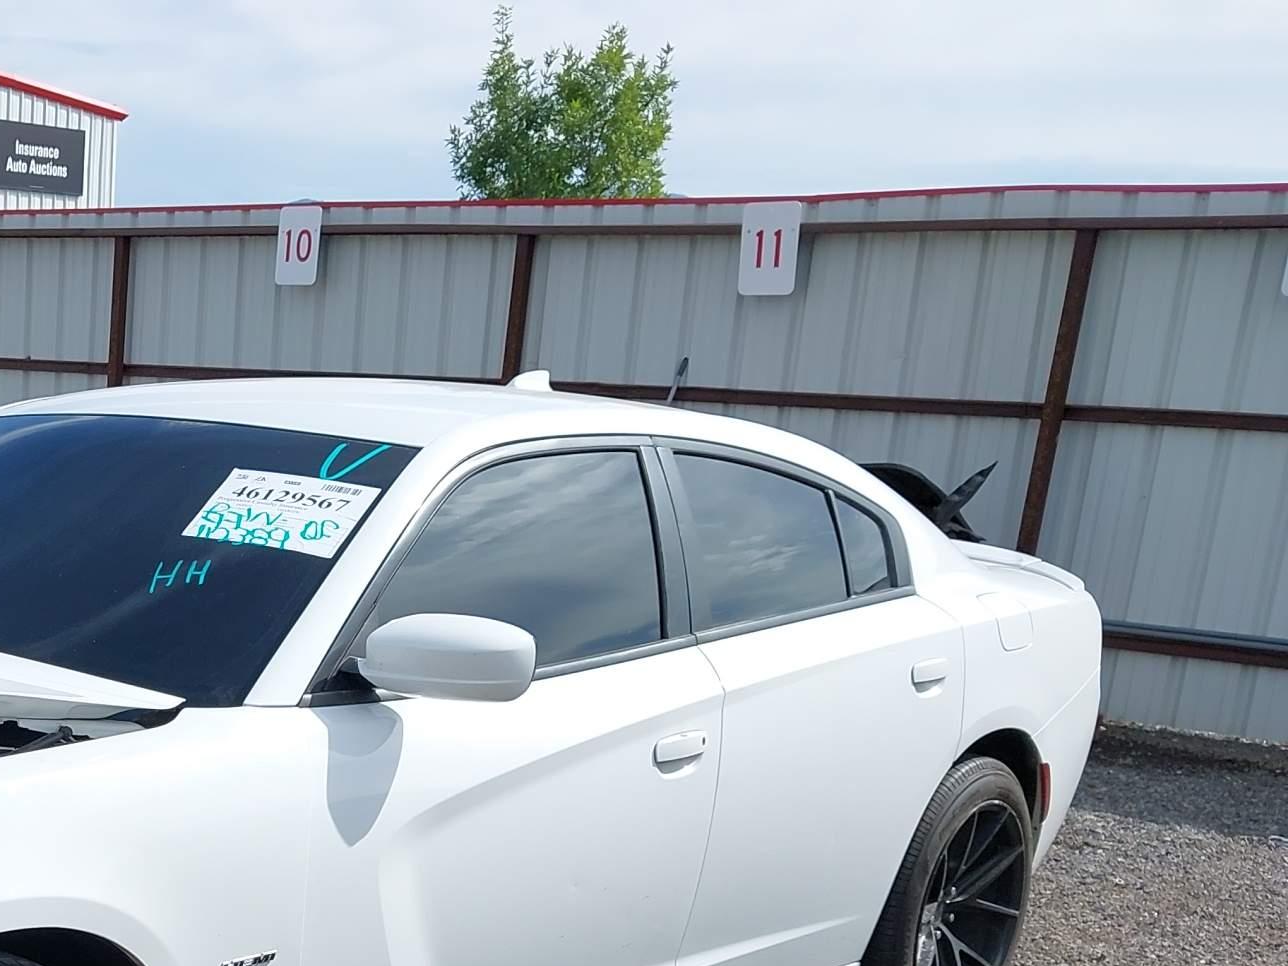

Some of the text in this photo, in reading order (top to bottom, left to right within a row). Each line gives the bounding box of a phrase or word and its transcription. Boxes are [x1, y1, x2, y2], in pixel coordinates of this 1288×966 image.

[15, 139, 60, 160] Insurance
[6, 156, 68, 178] Auto Auctions
[284, 228, 312, 263] 10
[755, 228, 783, 270] 11
[231, 484, 352, 512] 46129567
